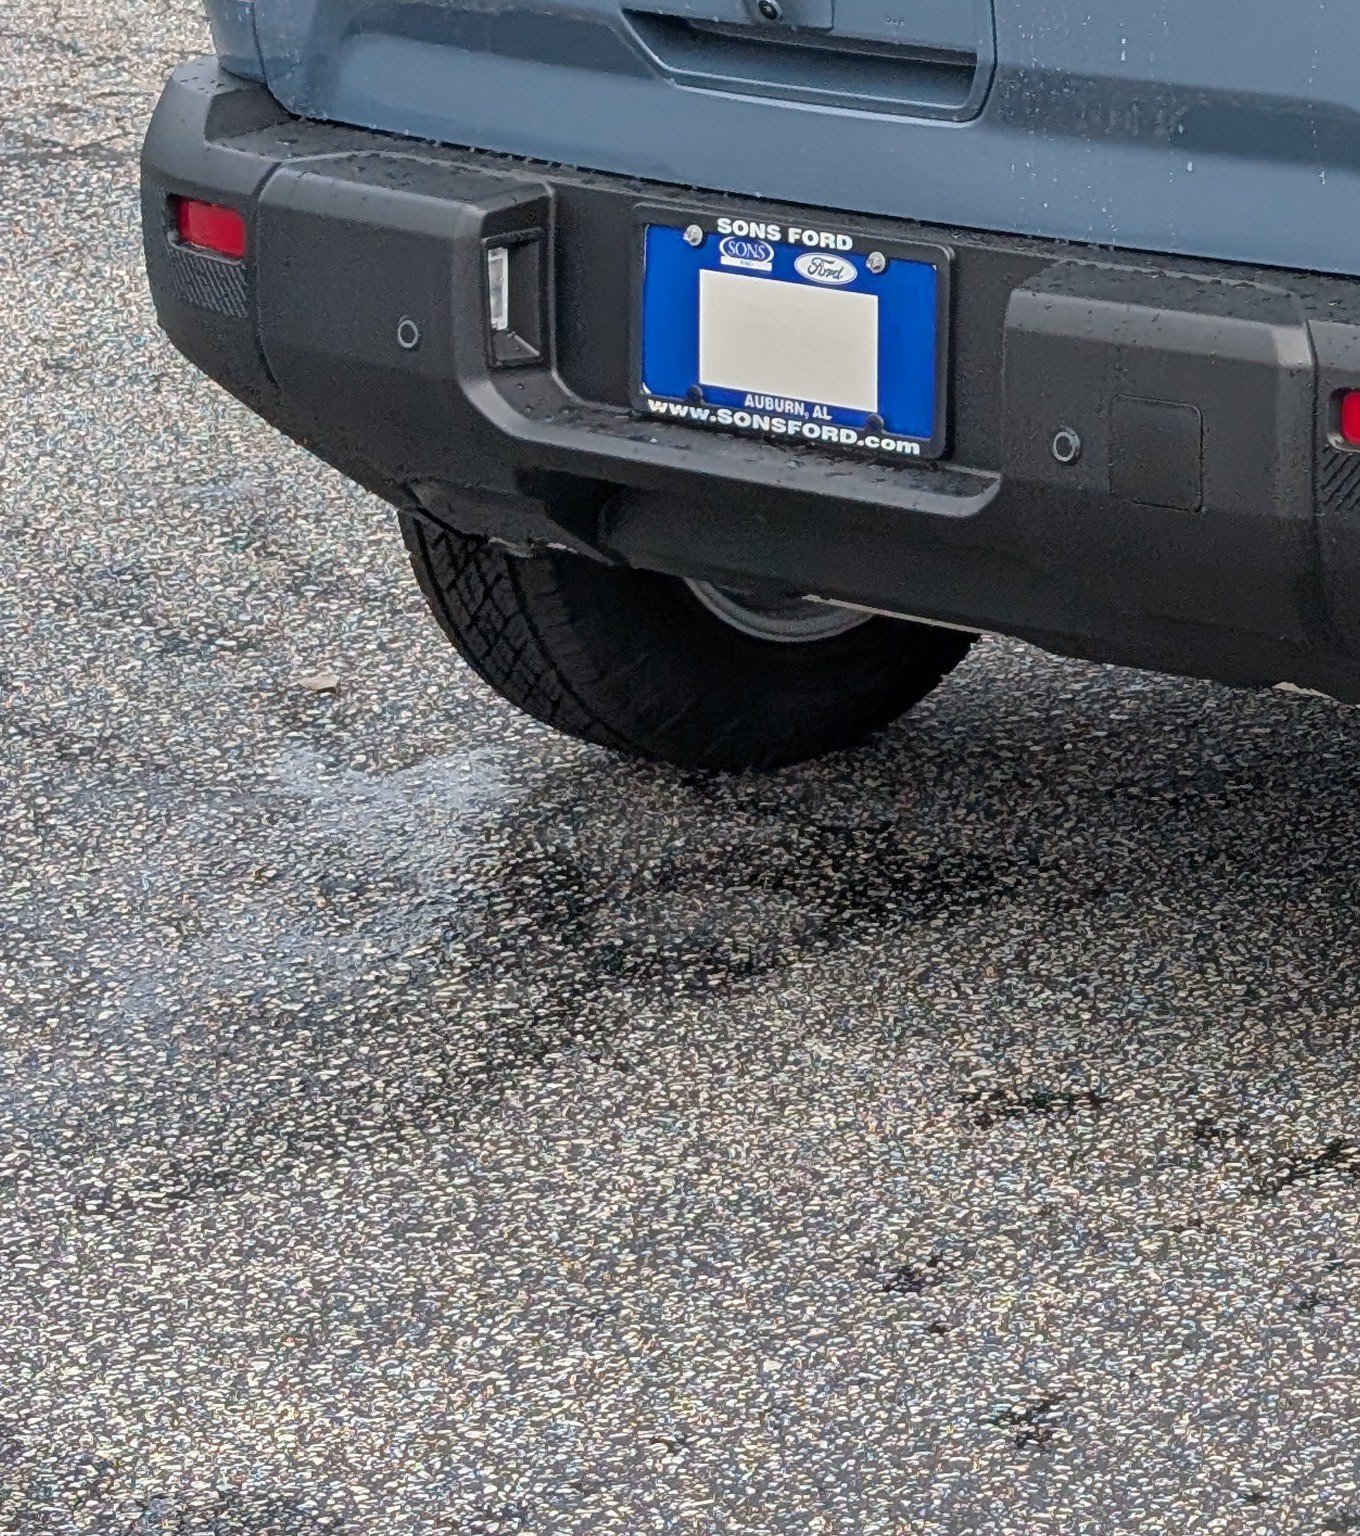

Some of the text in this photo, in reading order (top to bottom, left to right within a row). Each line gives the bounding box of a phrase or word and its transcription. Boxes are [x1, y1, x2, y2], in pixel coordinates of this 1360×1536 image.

[716, 217, 853, 251] SONS FORD
[727, 240, 766, 261] SONS
[807, 256, 843, 280] Ford
[743, 394, 832, 420] AUBURN, AL
[648, 398, 921, 456] www.SONSFORD.com
